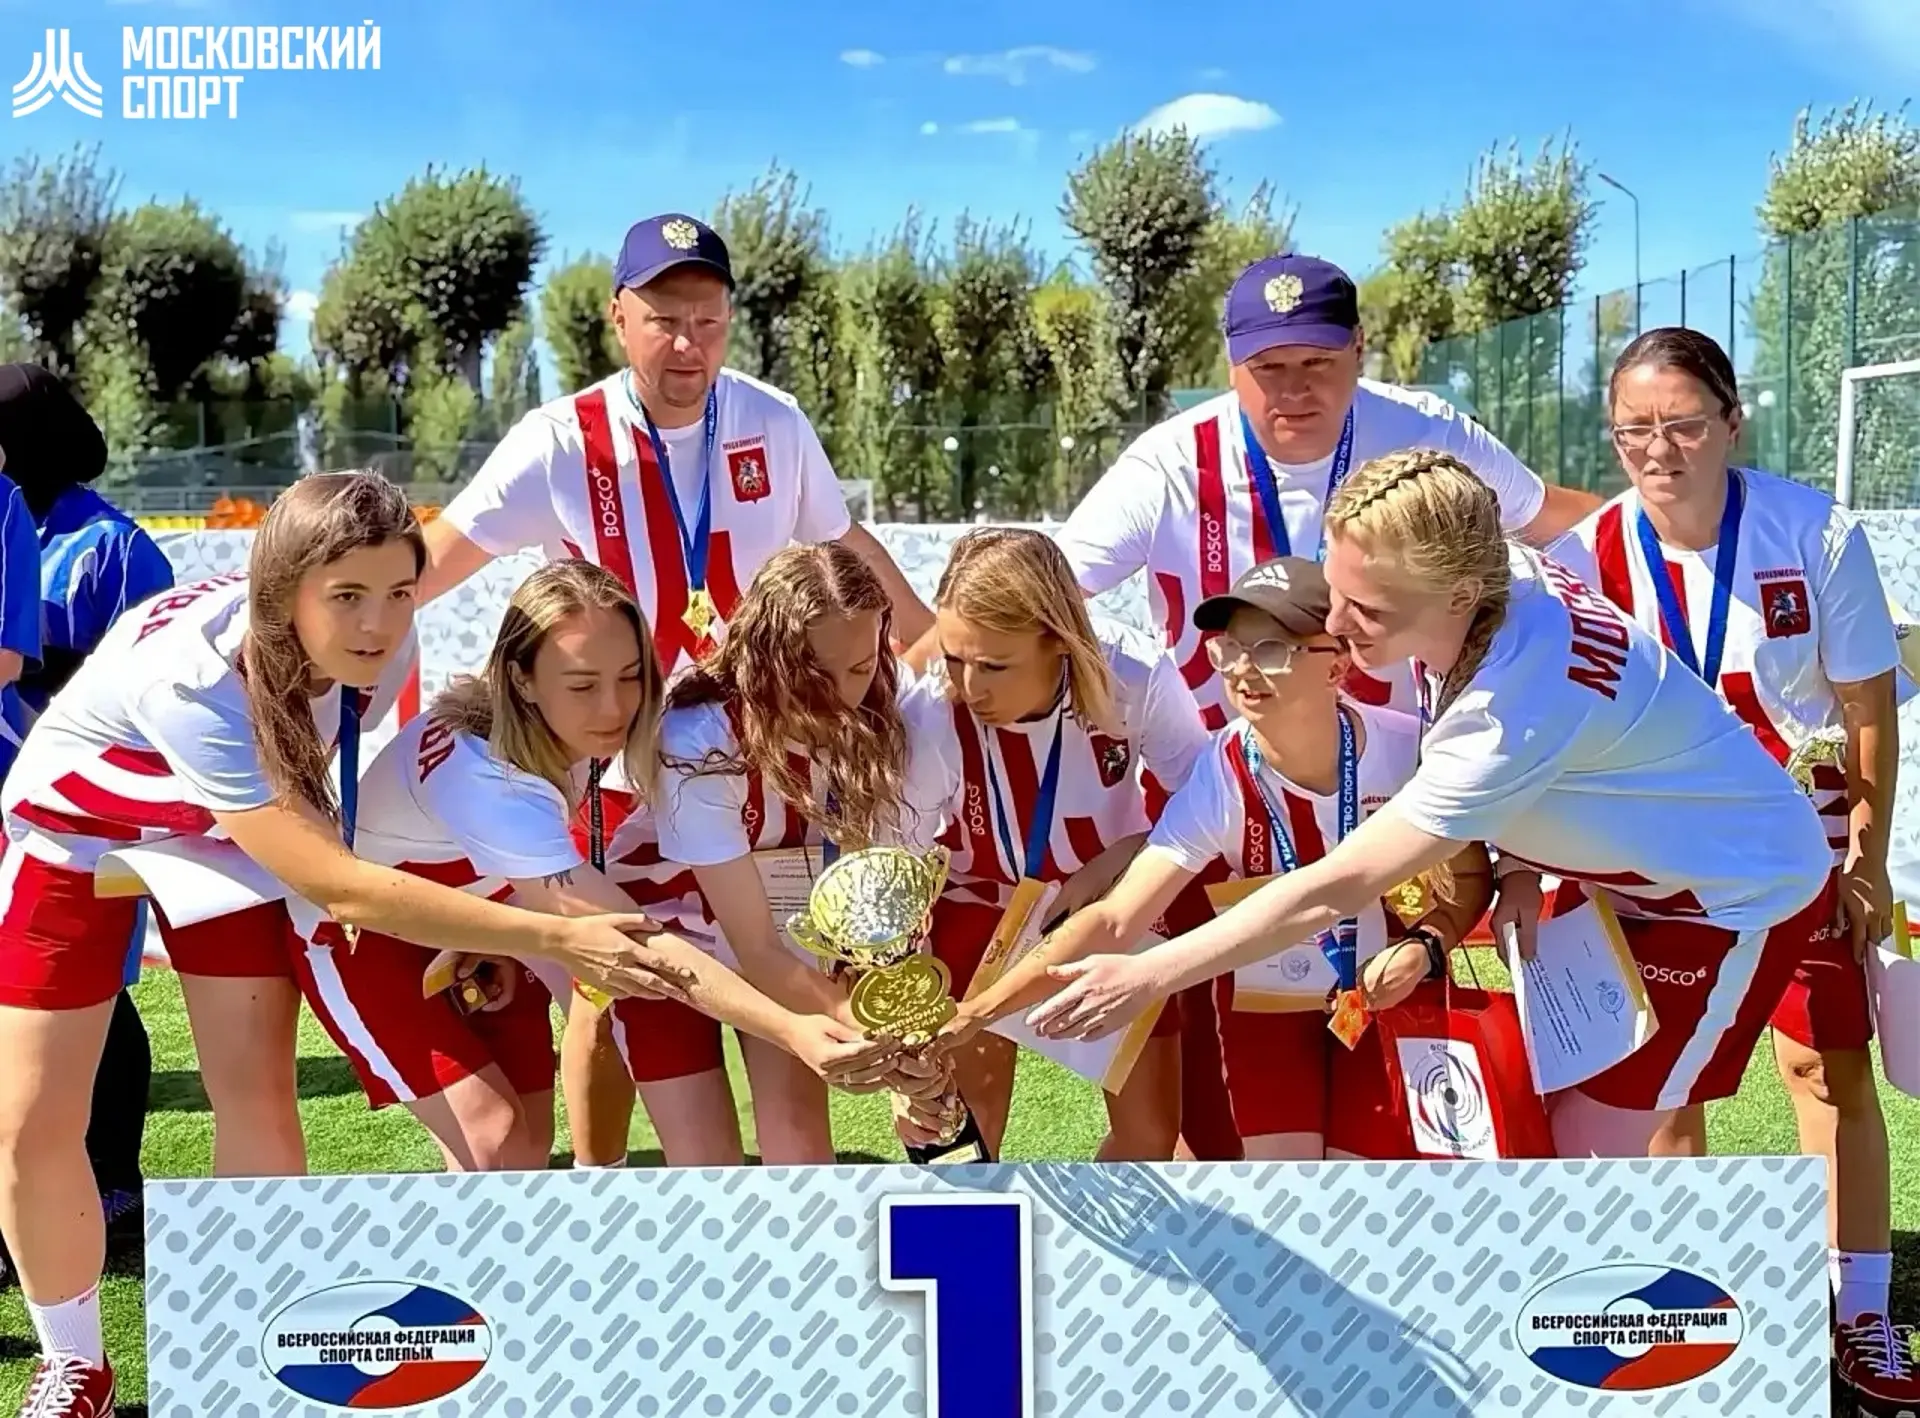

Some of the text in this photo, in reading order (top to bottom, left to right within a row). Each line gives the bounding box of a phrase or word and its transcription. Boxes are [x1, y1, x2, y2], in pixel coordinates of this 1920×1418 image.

[596, 475, 620, 537] BOSCO
[1206, 520, 1222, 573] BOSCO
[1344, 759, 1354, 803] СПОРТА
[968, 785, 985, 835] BOSCO
[1250, 823, 1264, 873] BOSCO
[893, 1015, 938, 1038] ОССИИ
[889, 1203, 1024, 1418] 1
[1532, 1311, 1727, 1330] ВСЕРОССИЙСКАЯ ФЕДЕРАЦИЯ
[278, 1329, 475, 1348] ВСЕРОССИЙСКАЯ ФЕДЕРАЦИЯ
[319, 1347, 434, 1363] СПОРТА СЛЕПЫХ
[1573, 1329, 1686, 1345] СПОРТА СЛЕПЫХ
